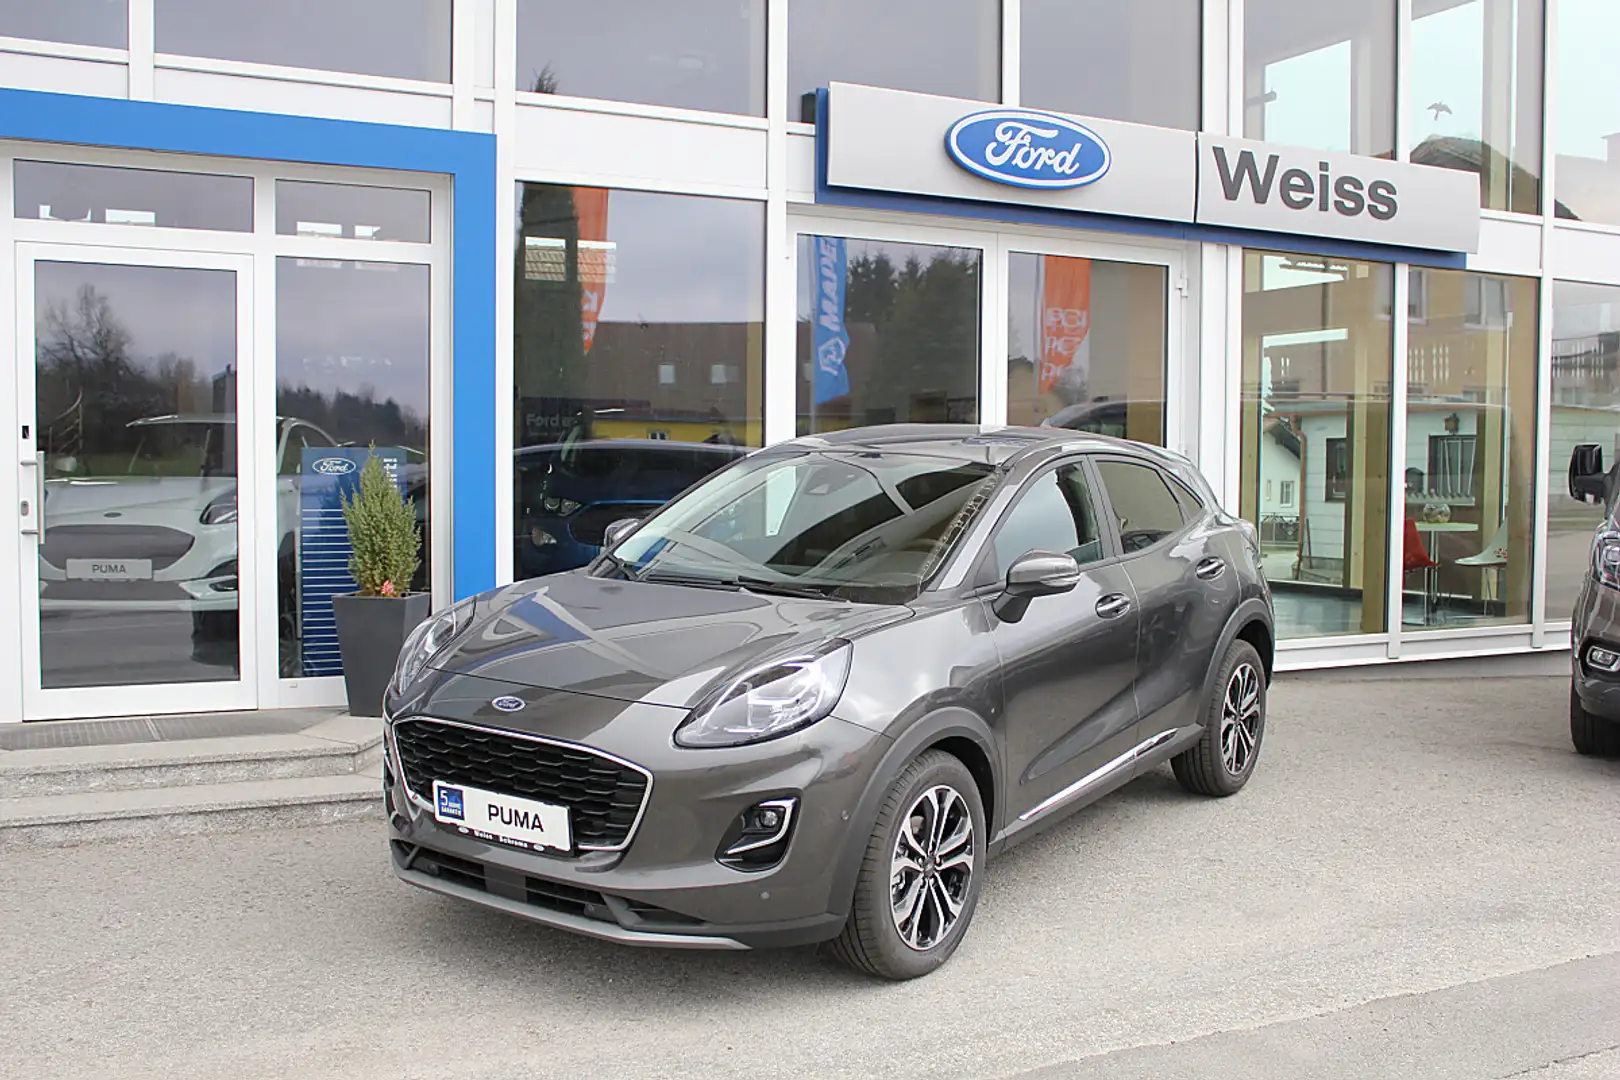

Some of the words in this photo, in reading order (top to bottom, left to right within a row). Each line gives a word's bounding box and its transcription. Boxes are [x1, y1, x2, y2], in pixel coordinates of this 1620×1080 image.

[985, 121, 1082, 174] Ford
[1212, 145, 1398, 221] Weiss
[320, 459, 349, 472] Ford
[91, 564, 127, 573] PUMA
[440, 789, 448, 806] 5
[487, 803, 544, 832] PUMA
